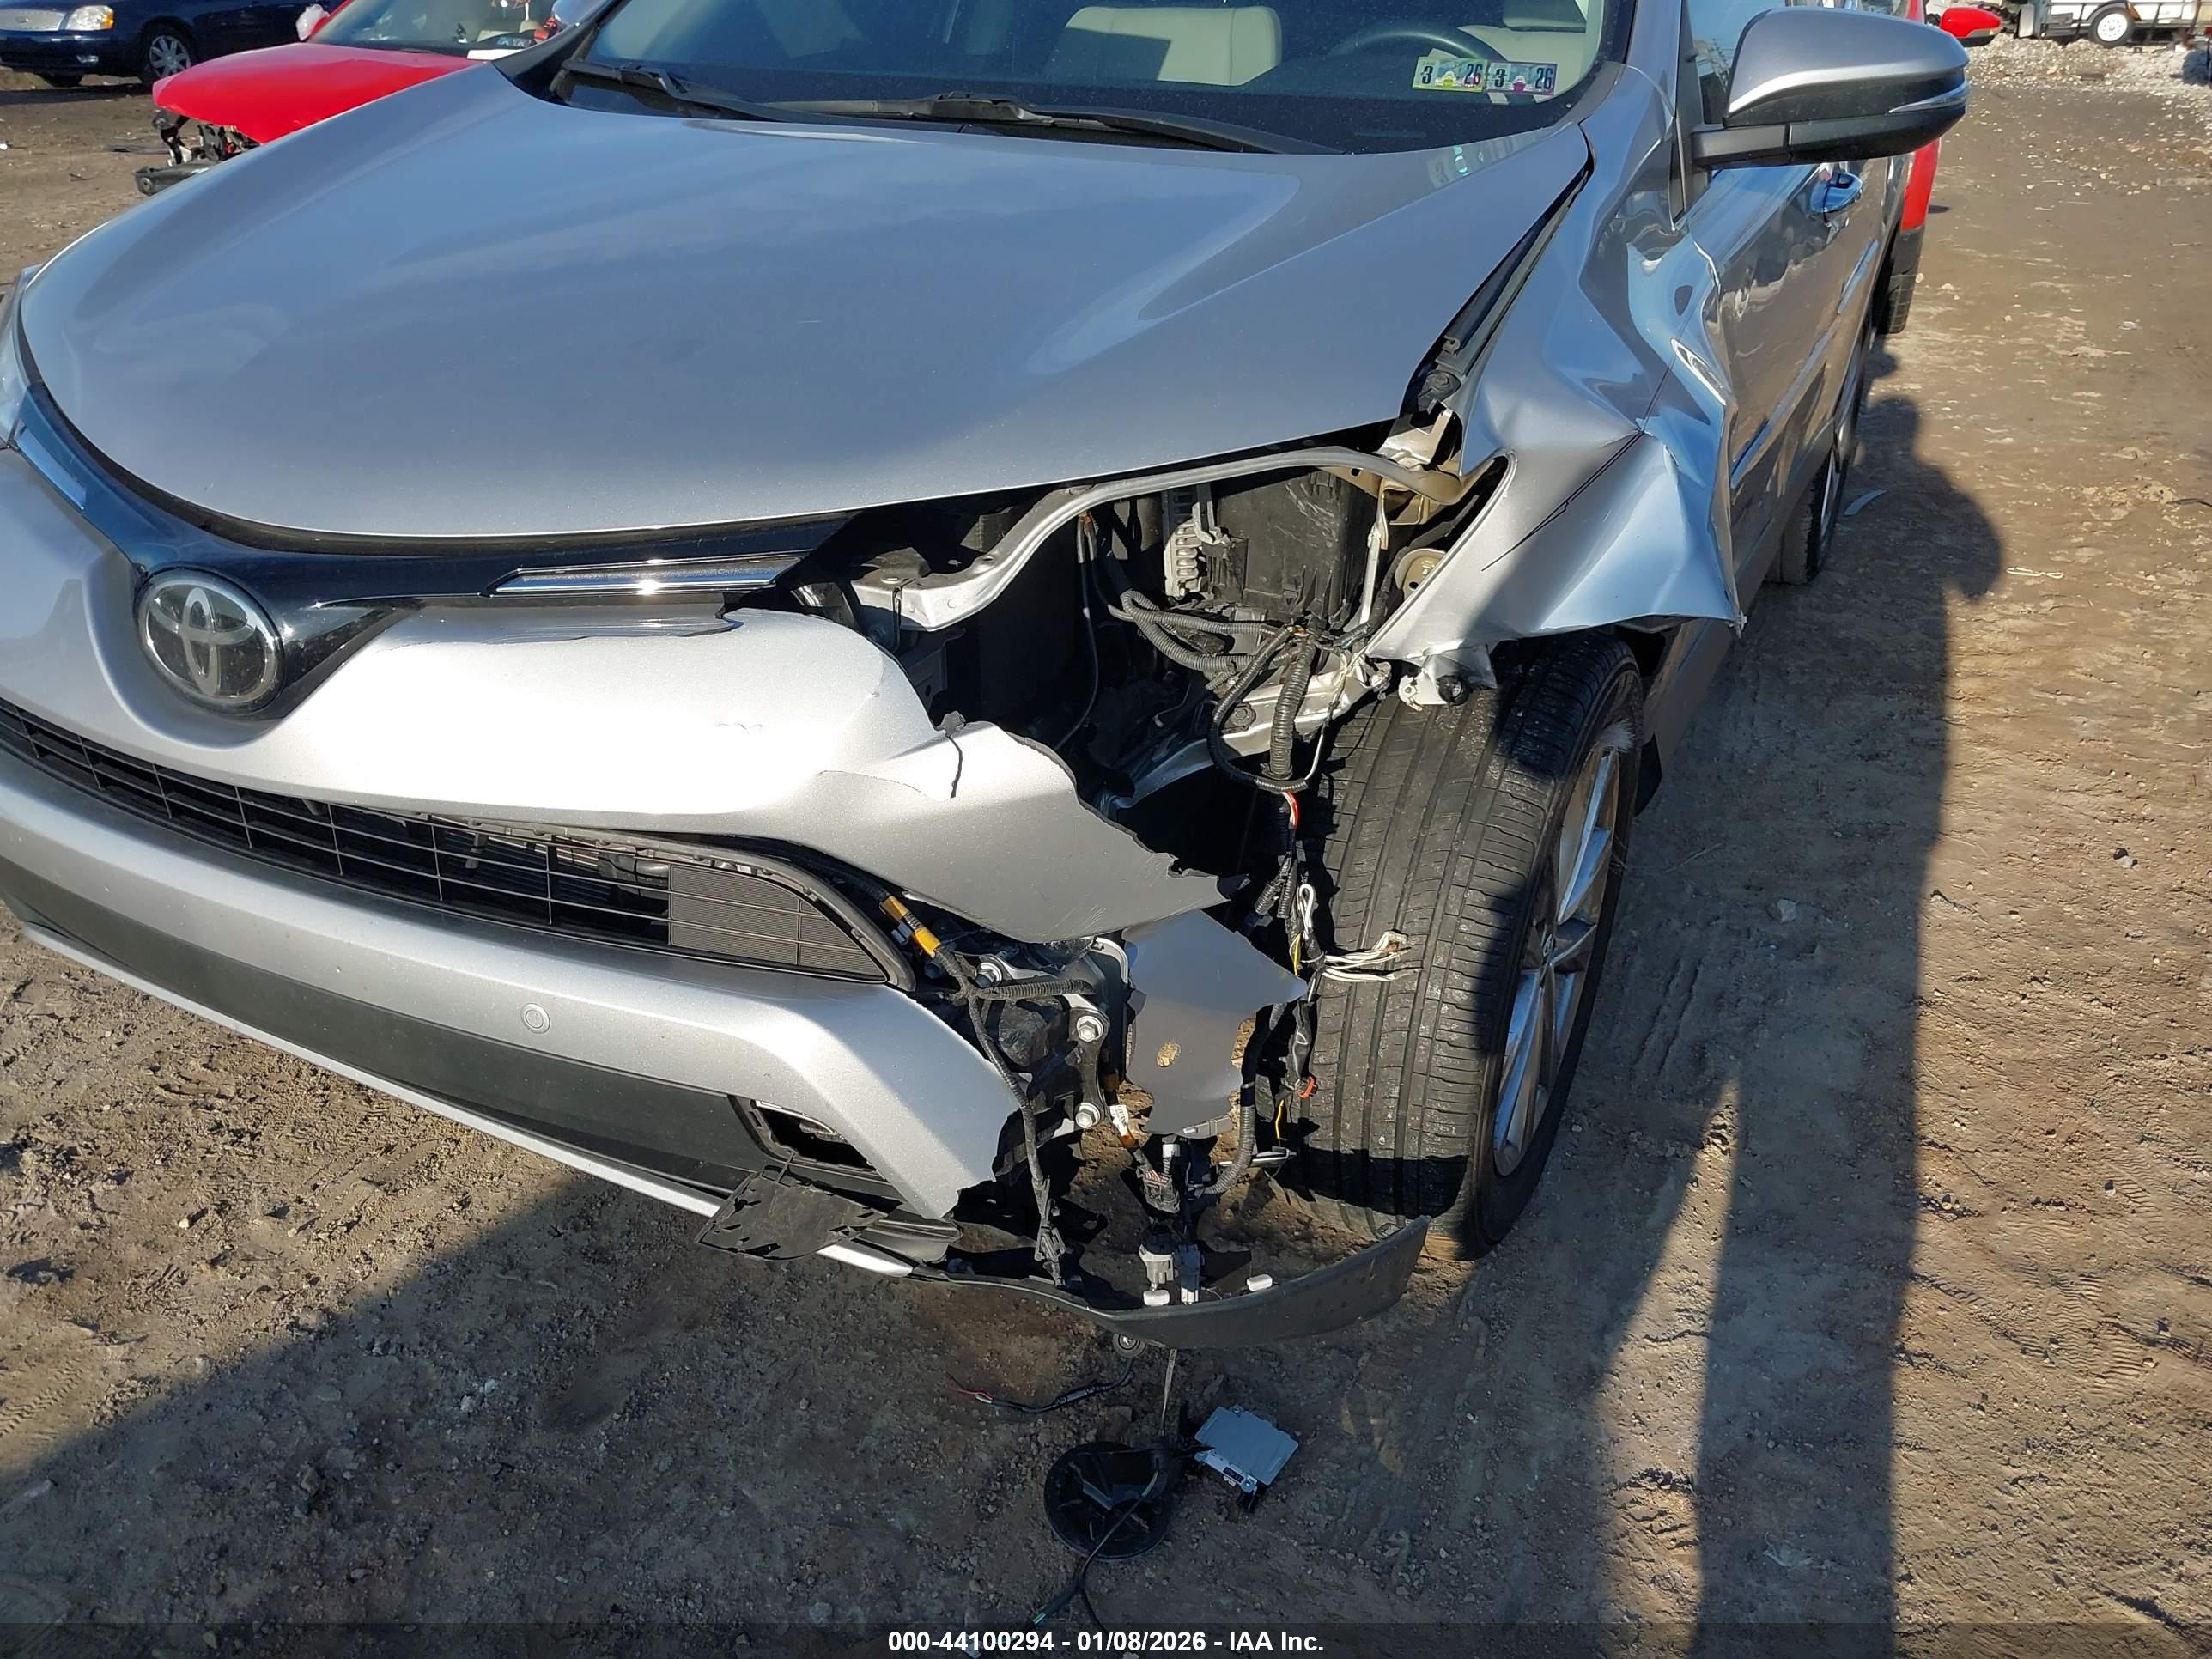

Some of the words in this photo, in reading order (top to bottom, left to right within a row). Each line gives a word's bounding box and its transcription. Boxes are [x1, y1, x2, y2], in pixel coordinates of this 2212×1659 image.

[1421, 65, 1434, 84] 3
[1464, 64, 1484, 85] 26
[1494, 68, 1507, 88] 3
[1534, 67, 1553, 90] 26
